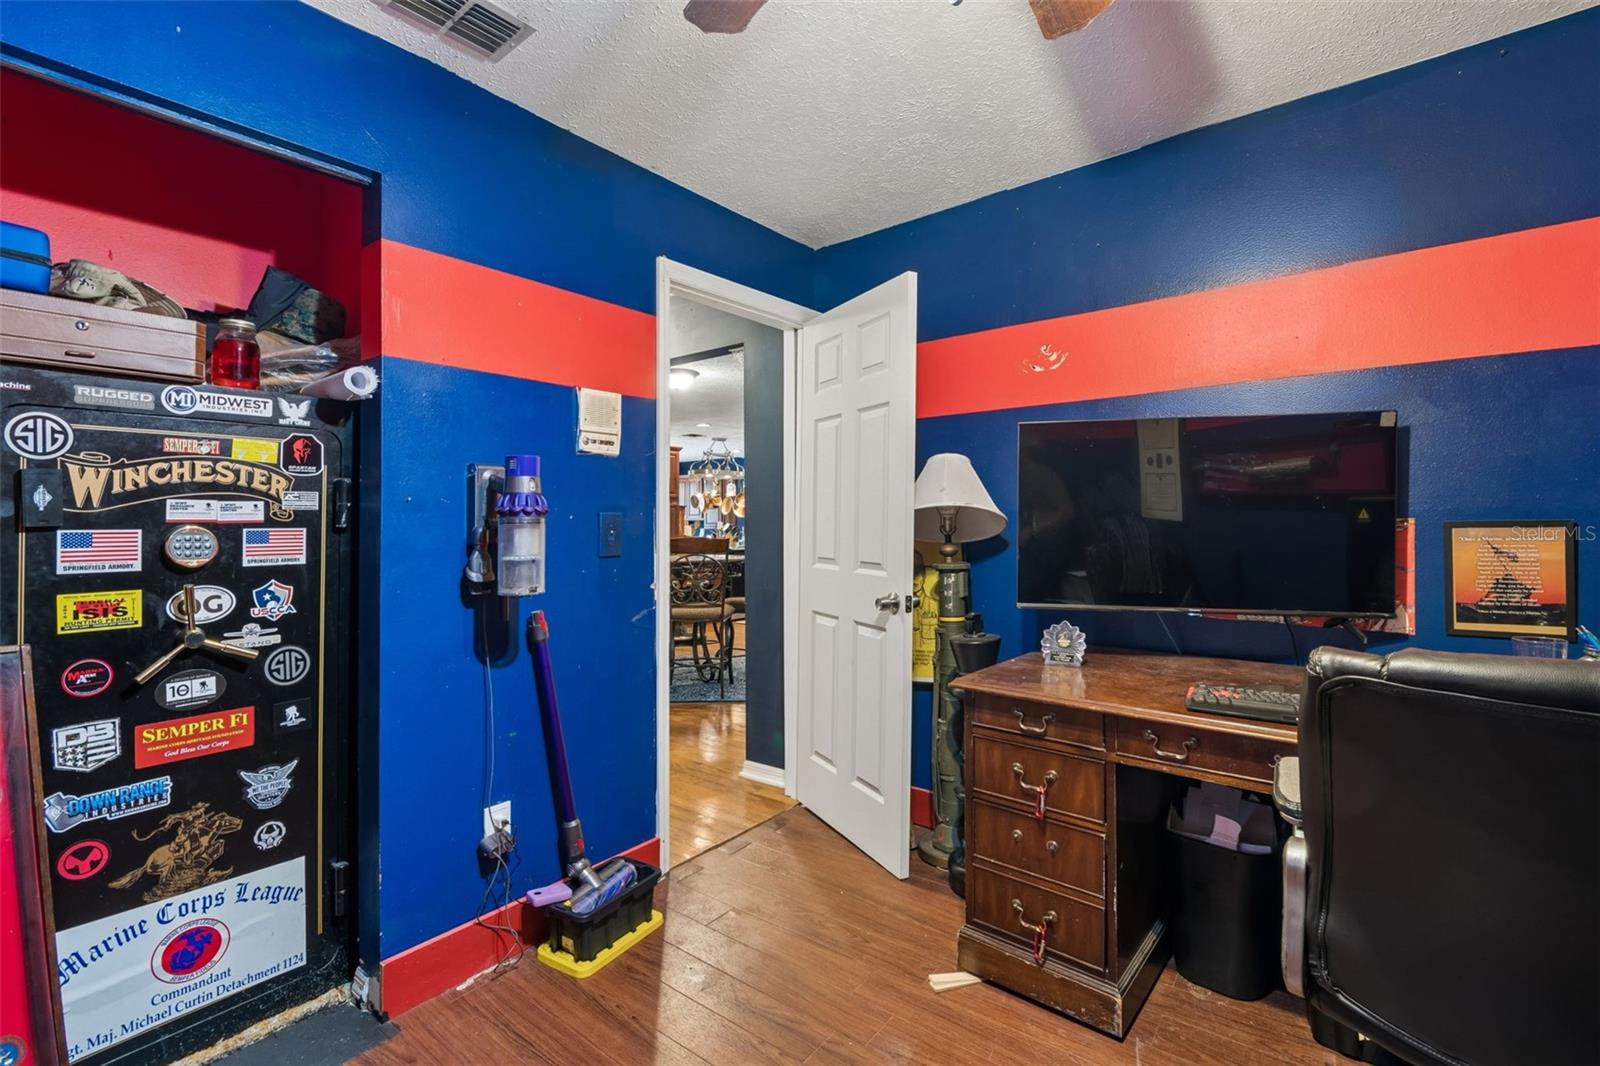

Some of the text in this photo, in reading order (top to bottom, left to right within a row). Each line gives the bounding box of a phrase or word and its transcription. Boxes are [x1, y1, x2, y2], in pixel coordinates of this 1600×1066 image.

[77, 386, 152, 403] RUGGED
[170, 390, 194, 407] MI
[199, 394, 270, 411] MIDWEST
[14, 417, 65, 453] SIG
[163, 437, 198, 453] SEMPER
[65, 460, 289, 509] WINCHESTER
[62, 564, 107, 572] SPRINGFIELD
[247, 557, 279, 565] SPRINGFIELD
[72, 605, 129, 621] ISIS
[251, 604, 297, 617] USCCA
[64, 618, 103, 627] HUNTING
[105, 616, 136, 624] PERMIT
[271, 650, 305, 682] SIG
[168, 683, 190, 699] 10
[142, 718, 225, 744] SEMPER
[164, 739, 230, 758] God Bless Our Corps
[269, 780, 287, 789] PEOPLE
[67, 790, 117, 818] DOWN
[118, 777, 168, 804] RANGE
[84, 792, 168, 819] INDUSTRIES
[58, 881, 303, 988] Marine Corps League
[150, 966, 232, 1007] Commandant
[68, 952, 304, 1061] gt. Maj. Michael Curtin Detachment 1124
